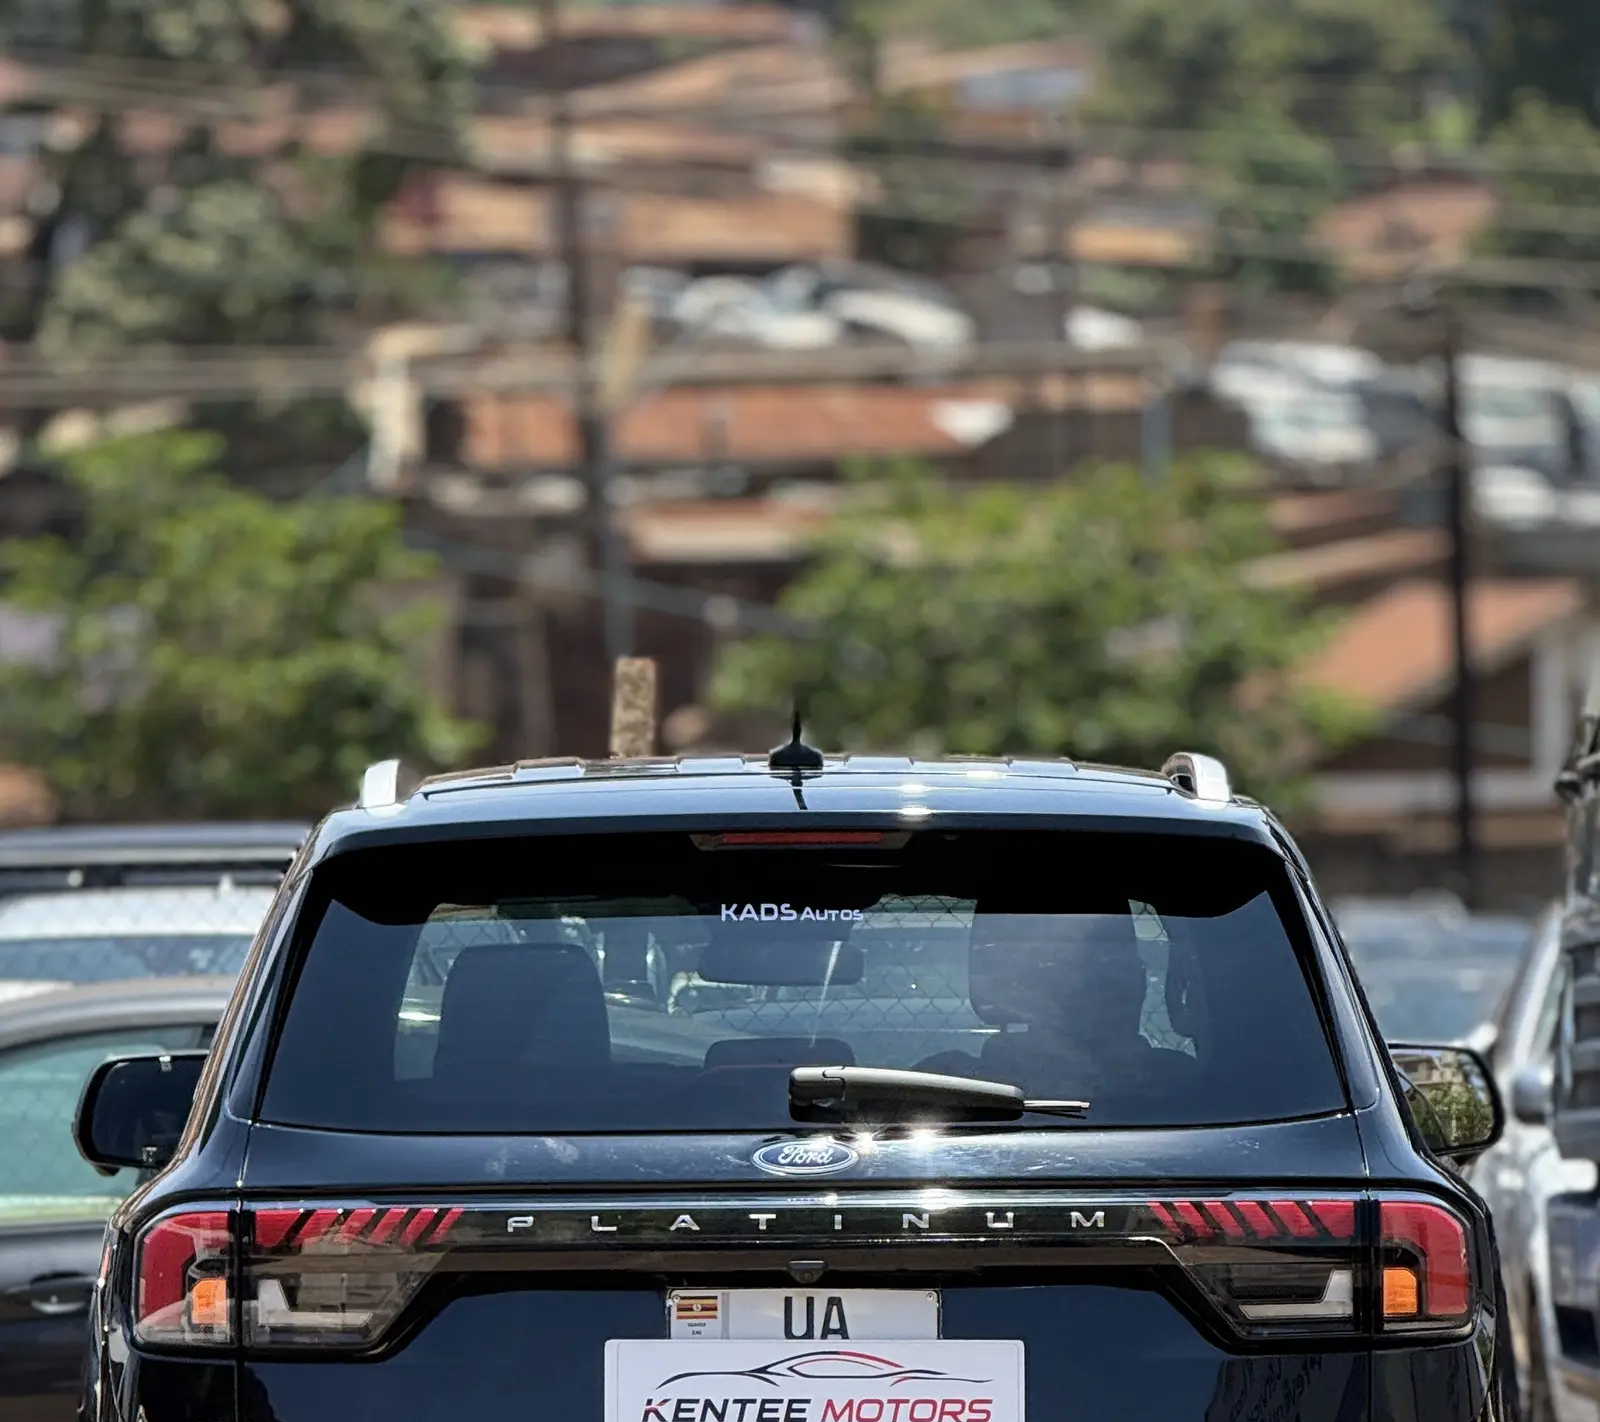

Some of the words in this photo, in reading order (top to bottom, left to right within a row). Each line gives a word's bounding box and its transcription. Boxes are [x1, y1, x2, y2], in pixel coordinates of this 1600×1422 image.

[720, 903, 798, 922] KADS
[777, 1145, 834, 1165] Ford
[507, 1213, 1105, 1232] PLATINUM
[783, 1295, 850, 1340] UA
[641, 1398, 811, 1422] KENTEE
